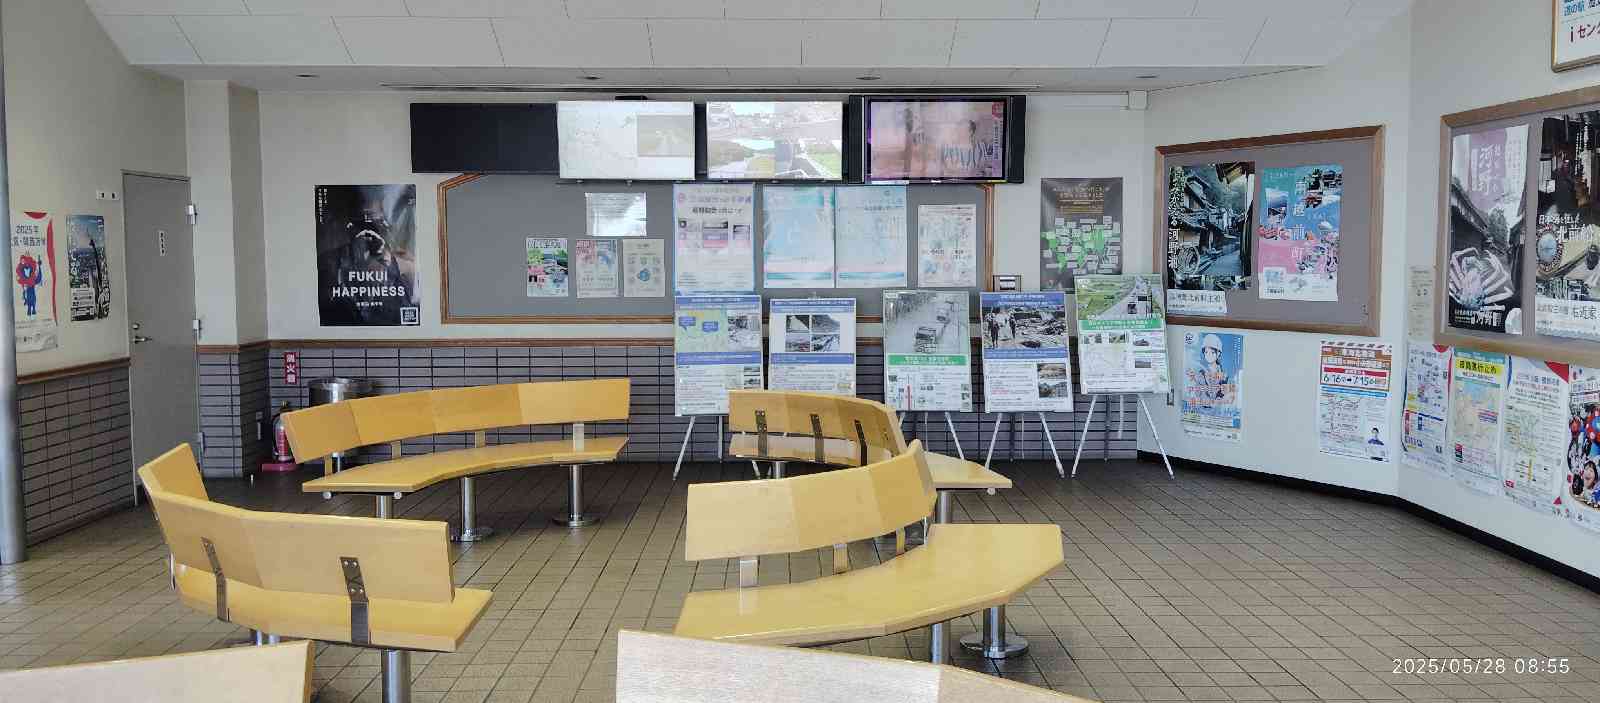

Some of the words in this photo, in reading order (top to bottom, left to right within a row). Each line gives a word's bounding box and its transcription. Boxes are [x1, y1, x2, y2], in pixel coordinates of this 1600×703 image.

[348, 271, 388, 281] FUKUI
[332, 286, 405, 297] HAPPINESS
[286, 353, 296, 383] 消火器
